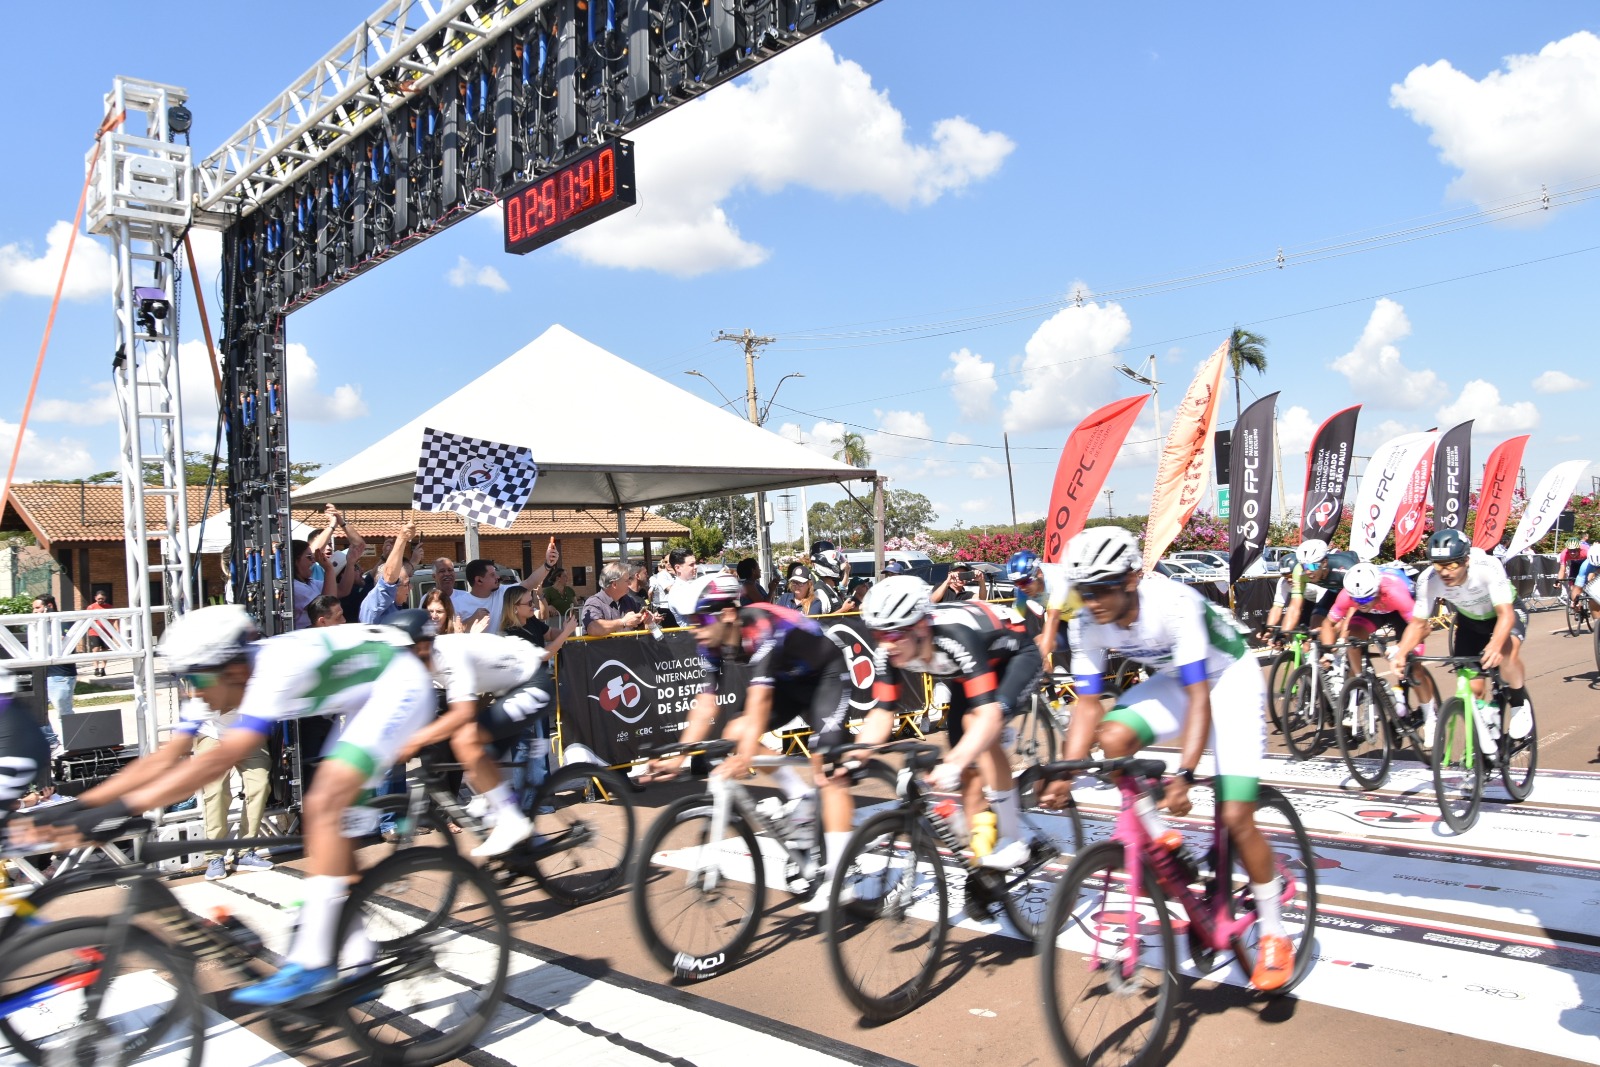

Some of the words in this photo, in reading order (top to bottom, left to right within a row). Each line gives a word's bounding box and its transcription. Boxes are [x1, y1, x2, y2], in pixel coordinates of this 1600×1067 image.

[1338, 441, 1348, 466] PAULO
[1067, 453, 1095, 501] FPC
[1244, 457, 1258, 493] FPC
[1329, 453, 1338, 480] ESTADO
[1336, 467, 1345, 482] SÃO
[1327, 481, 1335, 492] DO
[1335, 484, 1342, 493] DE
[1375, 468, 1395, 502] FPC
[1447, 466, 1459, 494] FPC
[1491, 472, 1506, 500] FPC
[1540, 491, 1557, 514] FPC
[655, 659, 682, 671] VOLTA
[657, 687, 675, 700] DO
[658, 702, 672, 715] DE
[675, 697, 698, 713] SÃO
[639, 726, 653, 735] CBC
